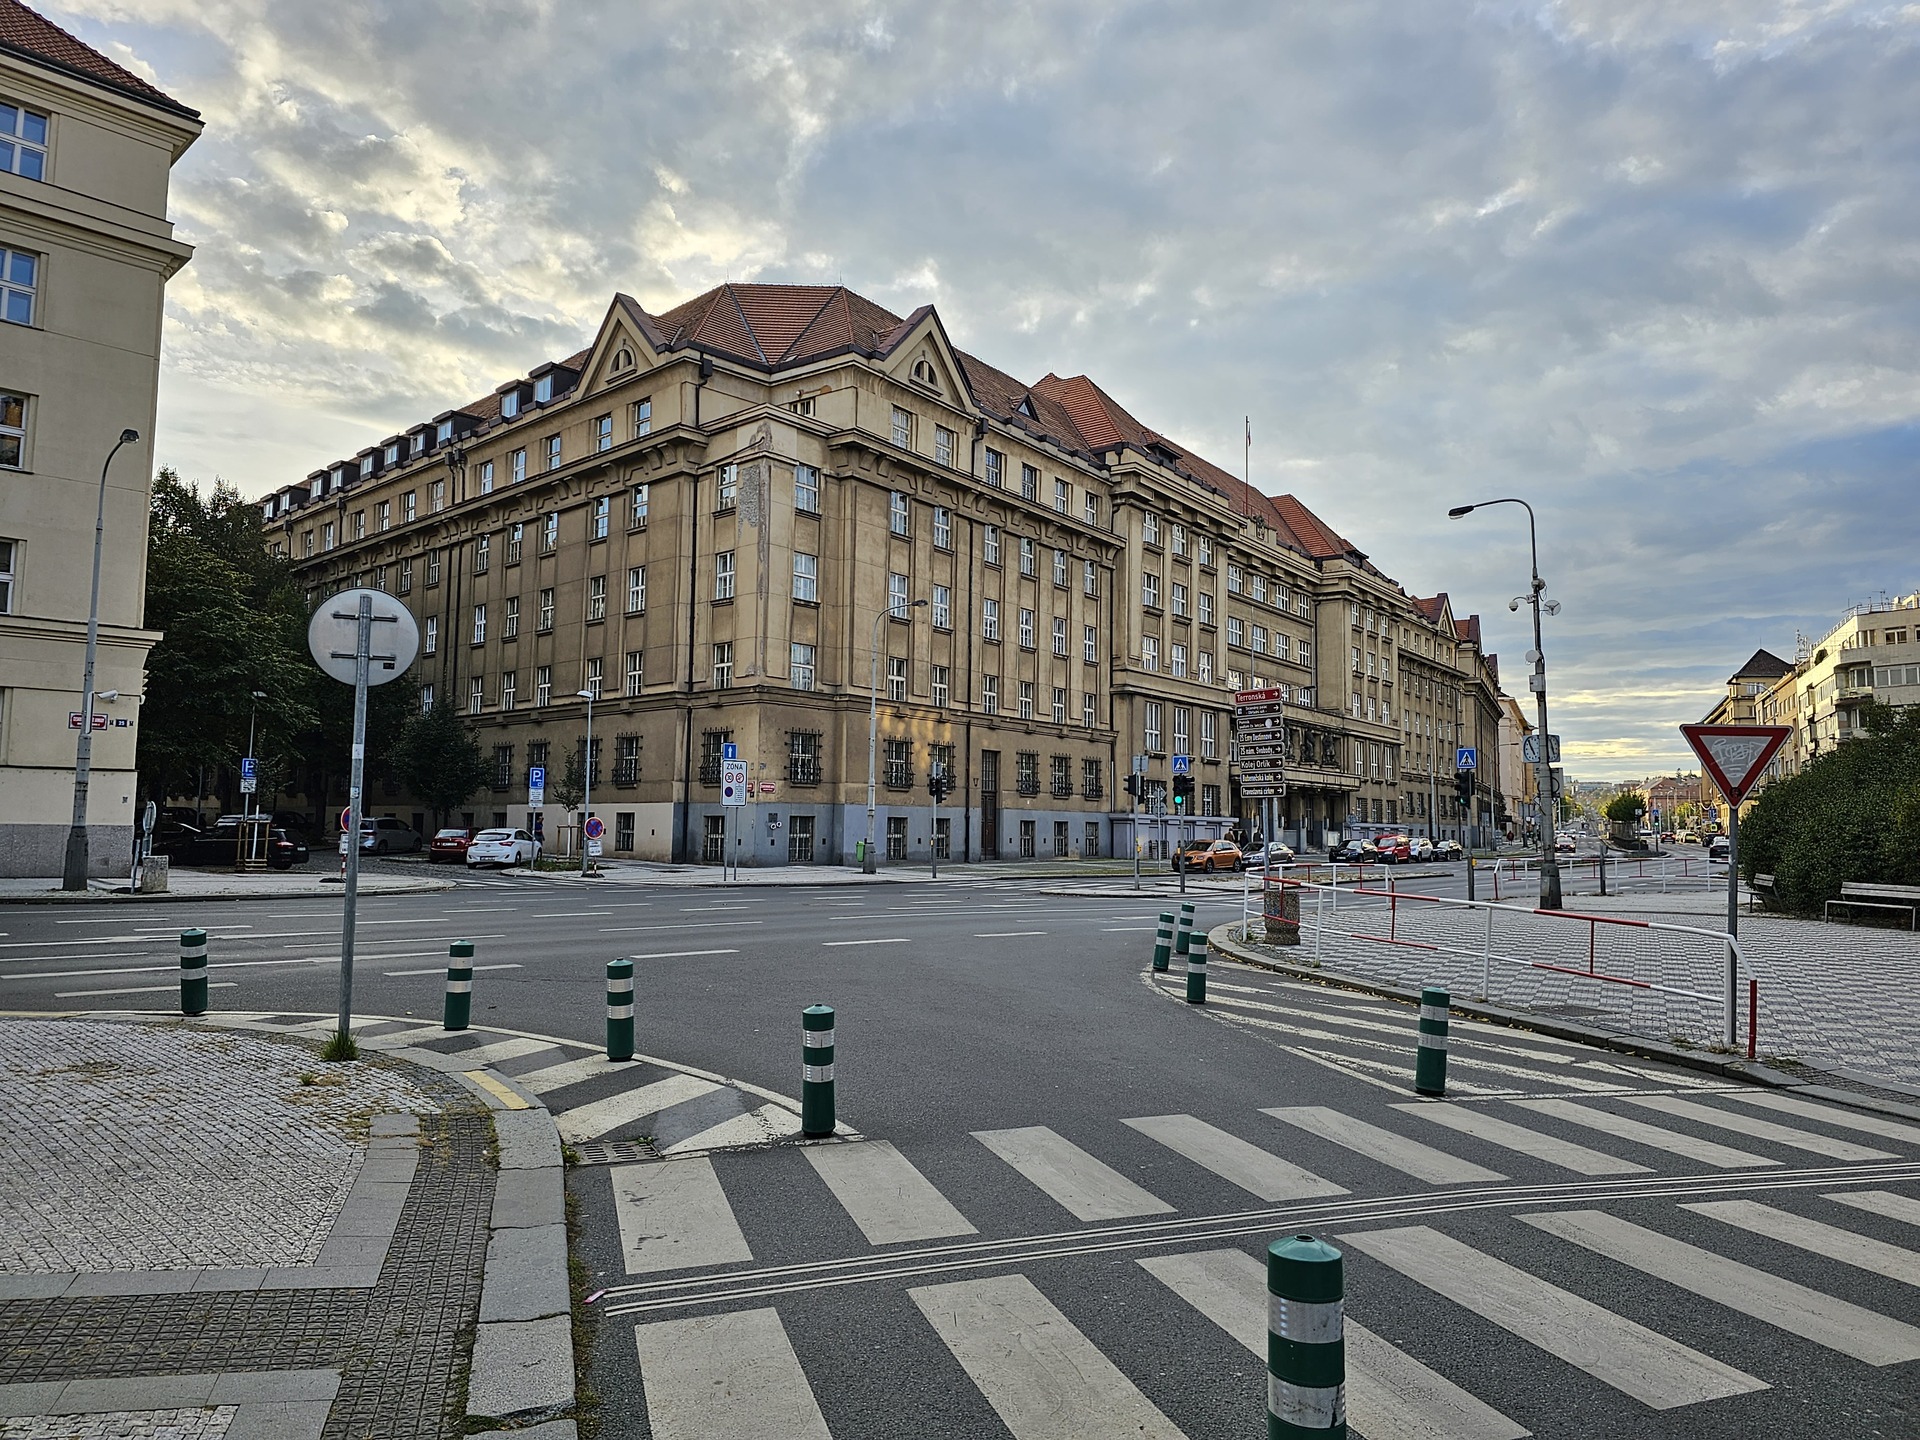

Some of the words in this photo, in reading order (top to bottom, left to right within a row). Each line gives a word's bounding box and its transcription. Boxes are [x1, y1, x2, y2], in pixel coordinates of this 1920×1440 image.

[1236, 692, 1266, 702] Terronská
[1241, 760, 1255, 769] Kolej
[1256, 760, 1271, 768] Orlík
